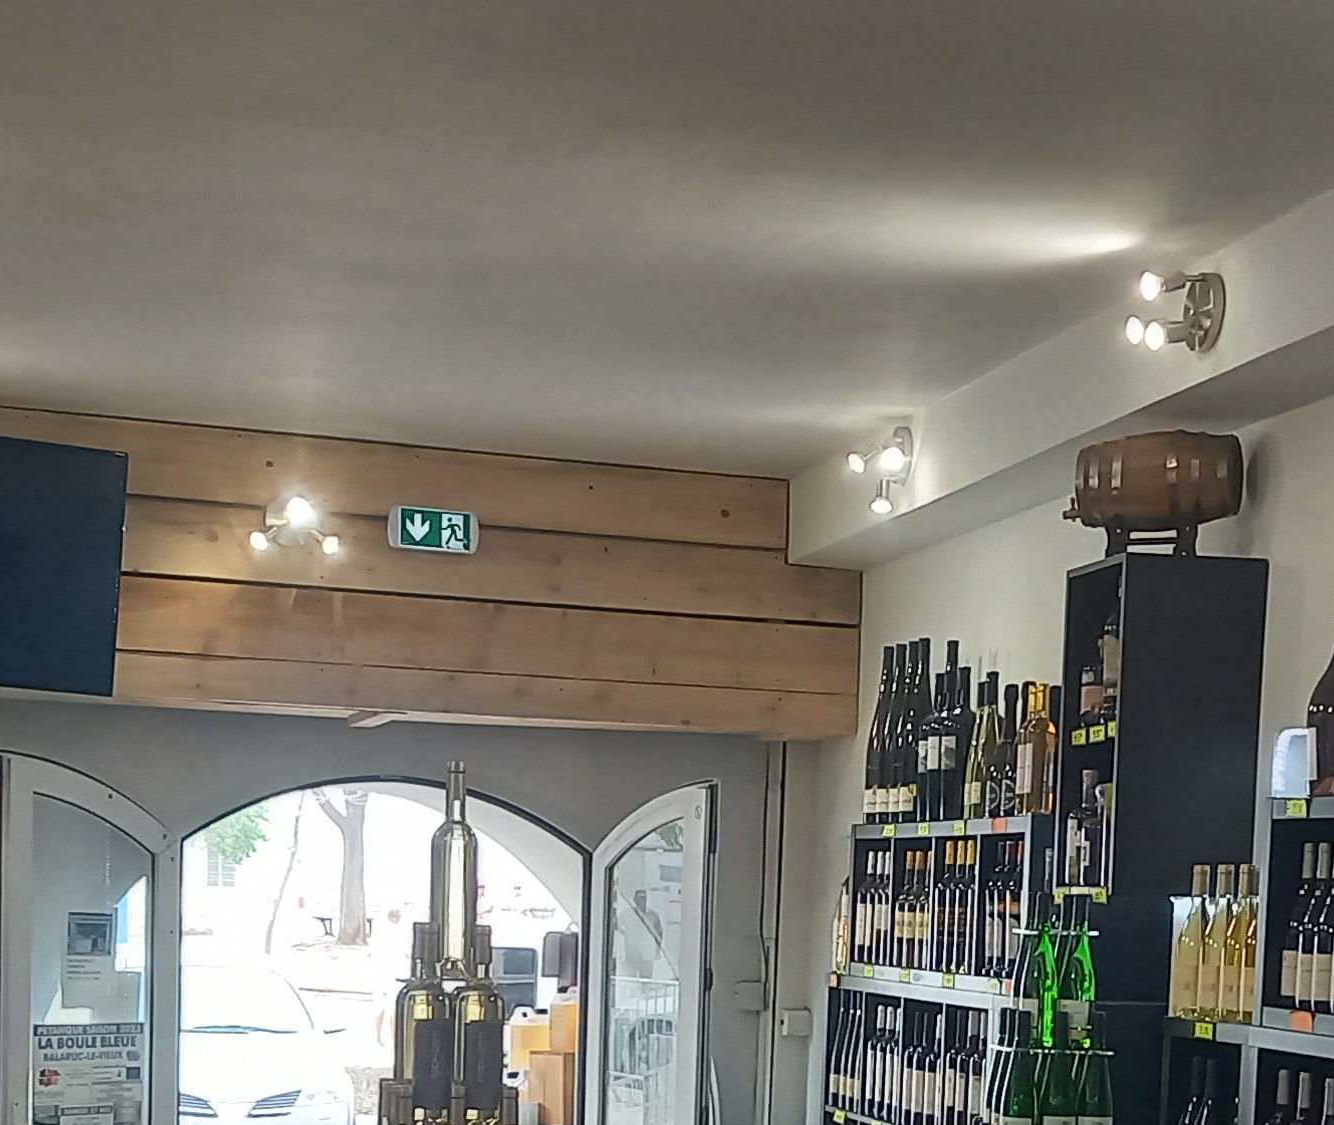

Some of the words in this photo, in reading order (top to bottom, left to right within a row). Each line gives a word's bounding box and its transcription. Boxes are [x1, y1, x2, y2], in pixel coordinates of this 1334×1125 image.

[38, 1038, 53, 1049] LA
[57, 1037, 97, 1049] BOULE
[101, 1036, 137, 1048] BLEUE
